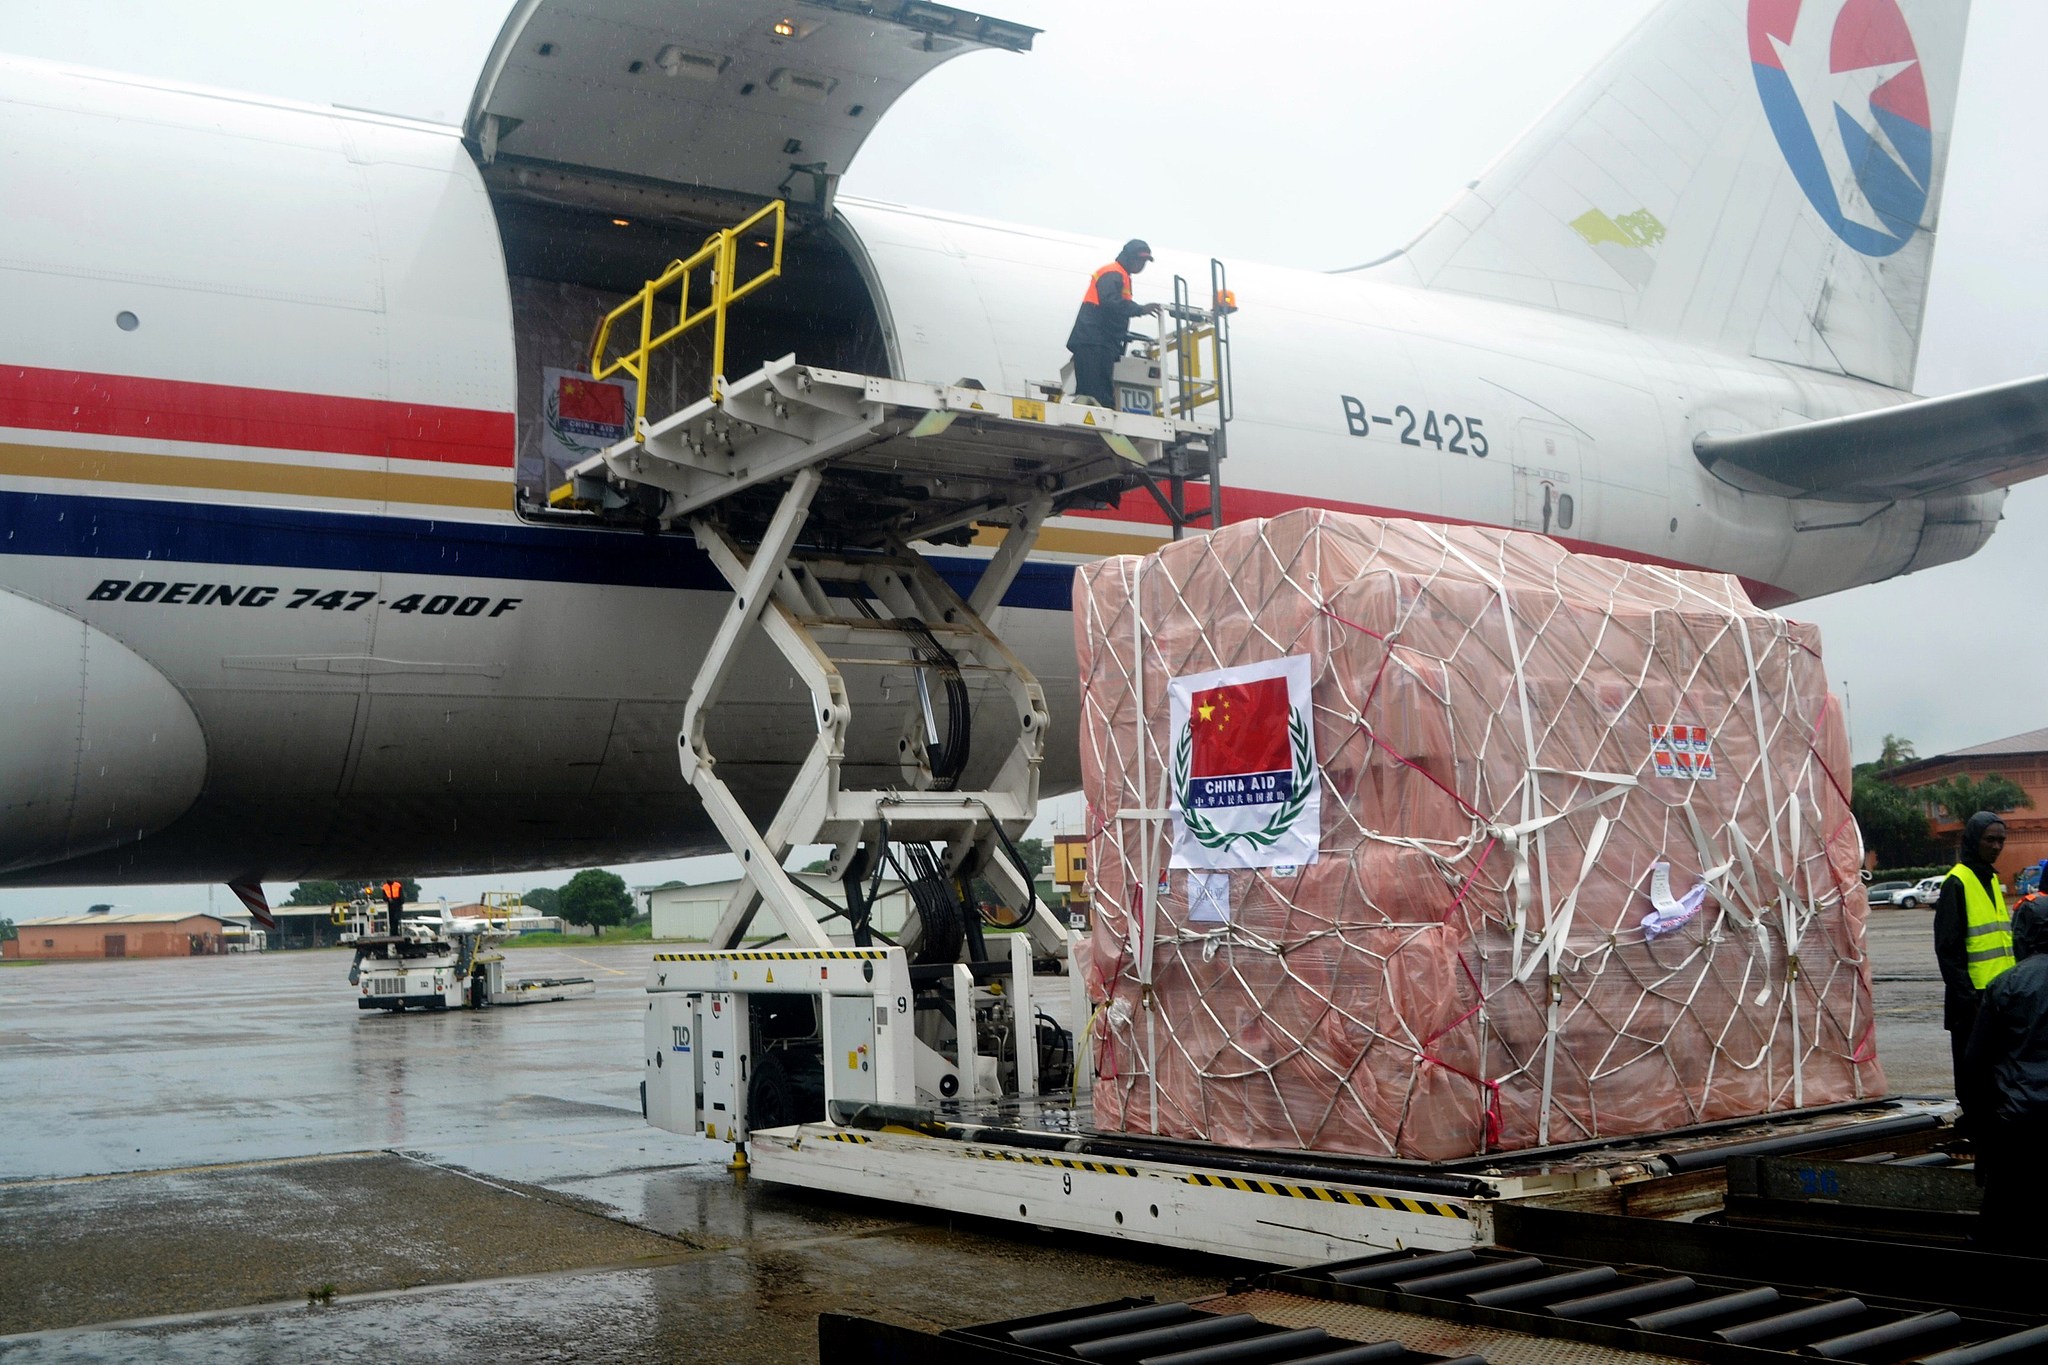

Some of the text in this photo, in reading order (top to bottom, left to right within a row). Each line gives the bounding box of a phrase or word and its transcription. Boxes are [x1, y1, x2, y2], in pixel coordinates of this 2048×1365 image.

[1121, 389, 1151, 410] TLD
[1341, 395, 1489, 458] B-2425
[86, 579, 279, 607] BOEING
[1205, 776, 1276, 794] CHINA AID
[896, 996, 907, 1014] 9
[672, 1025, 690, 1047] TLD
[714, 1061, 721, 1077] 9
[1063, 1172, 1072, 1195] 9
